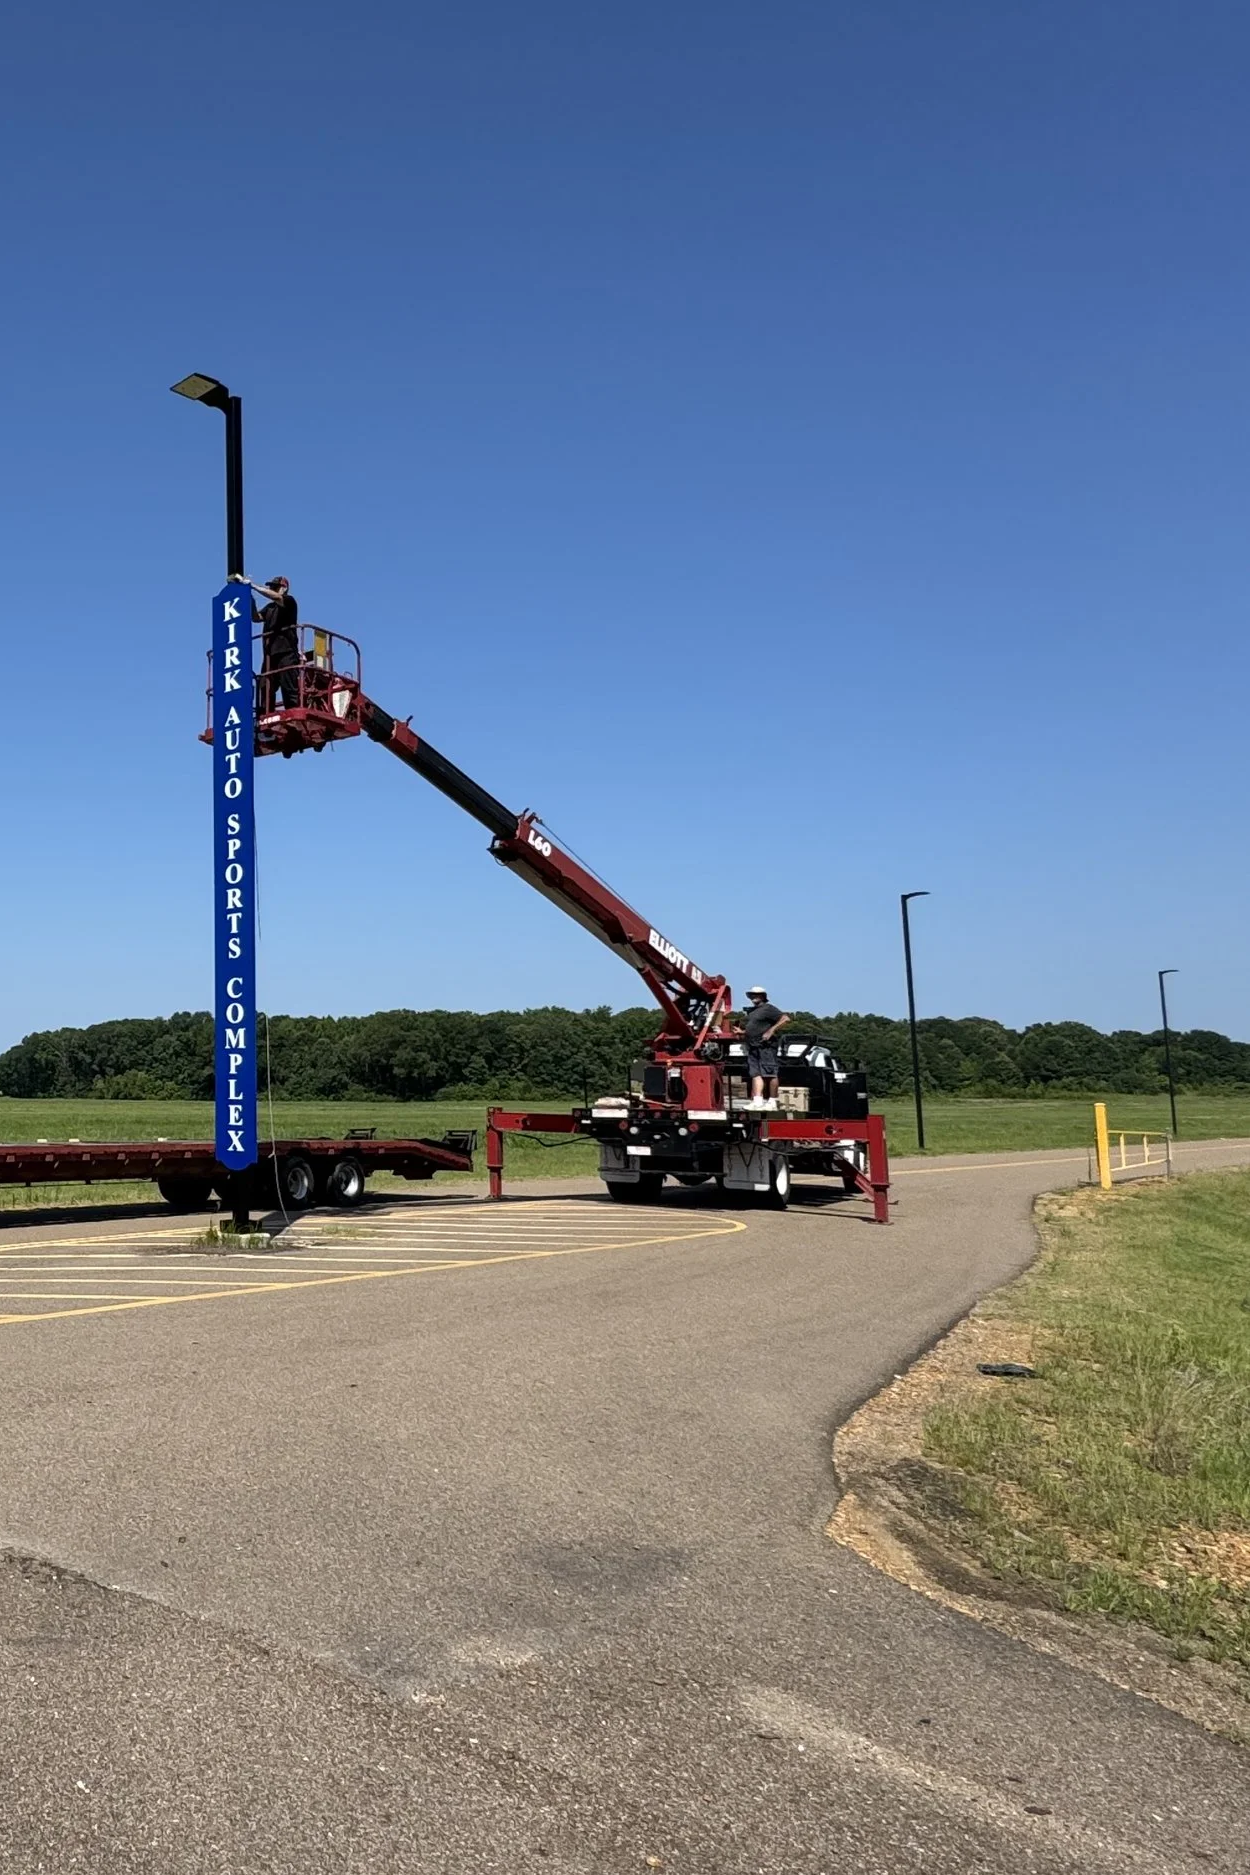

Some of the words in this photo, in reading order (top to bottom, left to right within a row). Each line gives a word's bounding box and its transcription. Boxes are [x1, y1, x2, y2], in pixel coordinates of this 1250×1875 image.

[223, 597, 241, 693] KIRK
[224, 706, 242, 799] AUTO
[225, 813, 243, 959] SPORTS
[528, 829, 551, 857] L60
[648, 928, 689, 973] ELLIOTT
[224, 977, 246, 1152] COMPLEX
